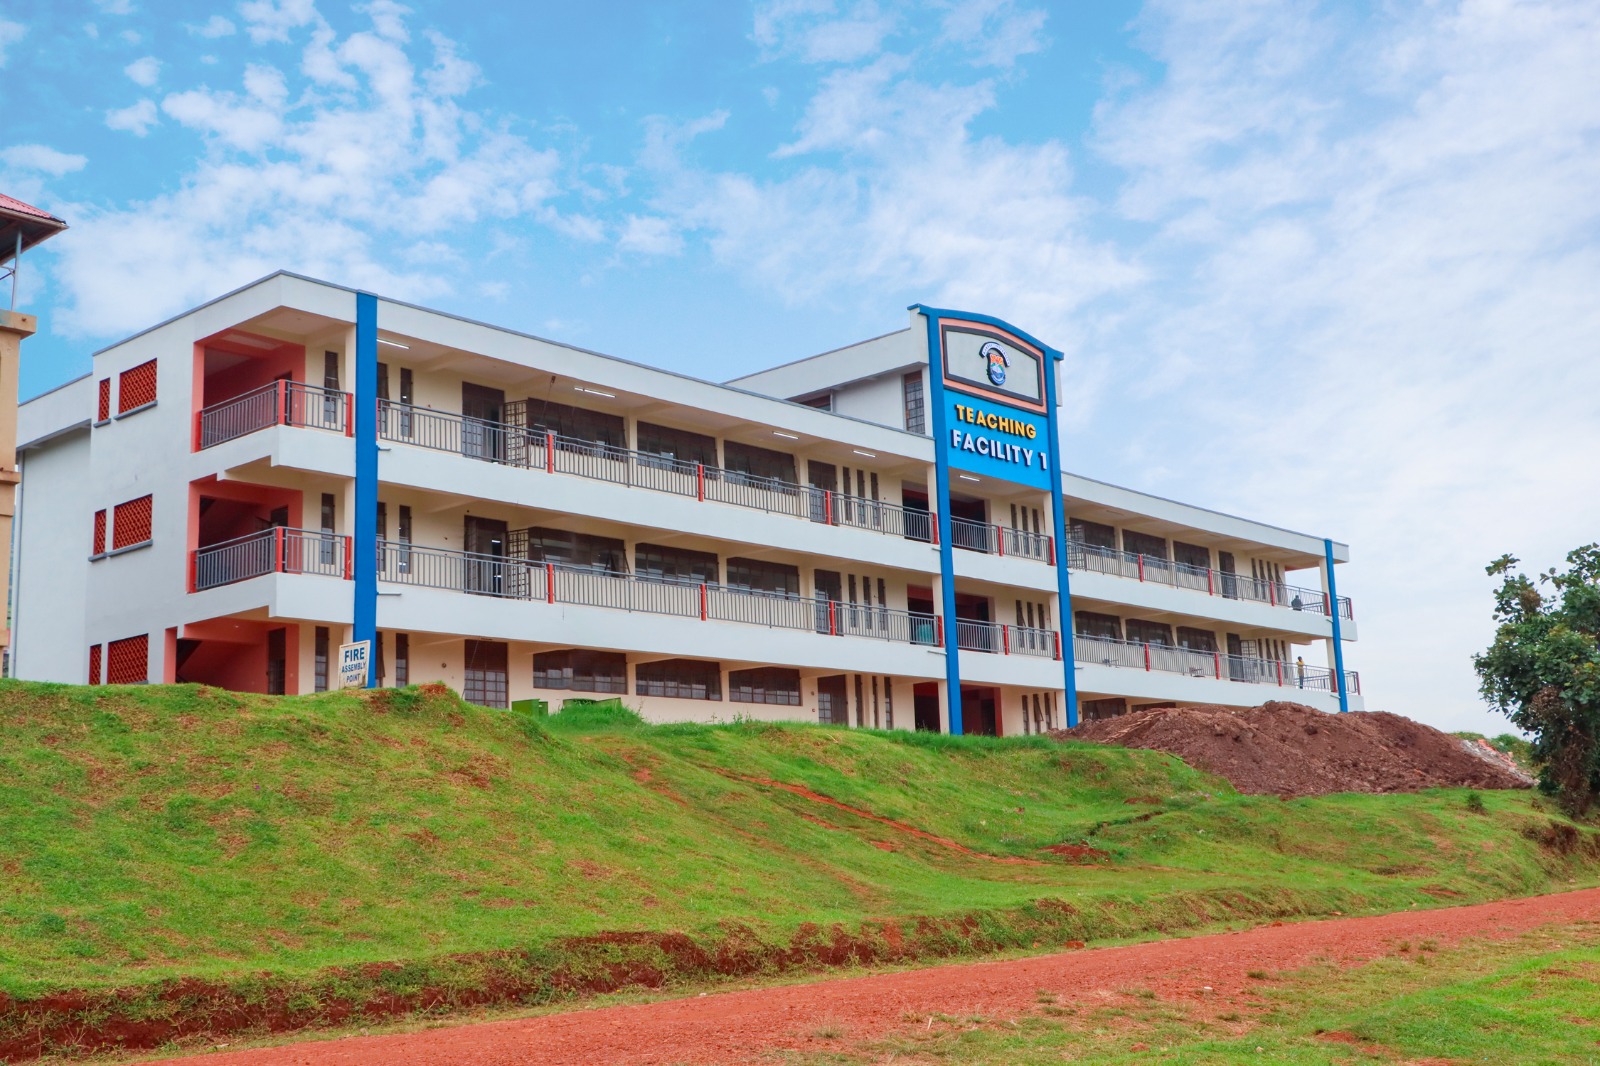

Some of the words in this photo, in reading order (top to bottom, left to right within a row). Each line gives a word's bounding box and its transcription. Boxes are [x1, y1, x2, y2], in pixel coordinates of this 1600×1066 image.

[956, 404, 1036, 439] TEACHING
[952, 429, 1033, 465] FACILITY
[1039, 452, 1047, 469] 1
[344, 647, 365, 663] FIRE
[341, 661, 366, 673] ASSEMBLY
[346, 673, 360, 682] POINT
